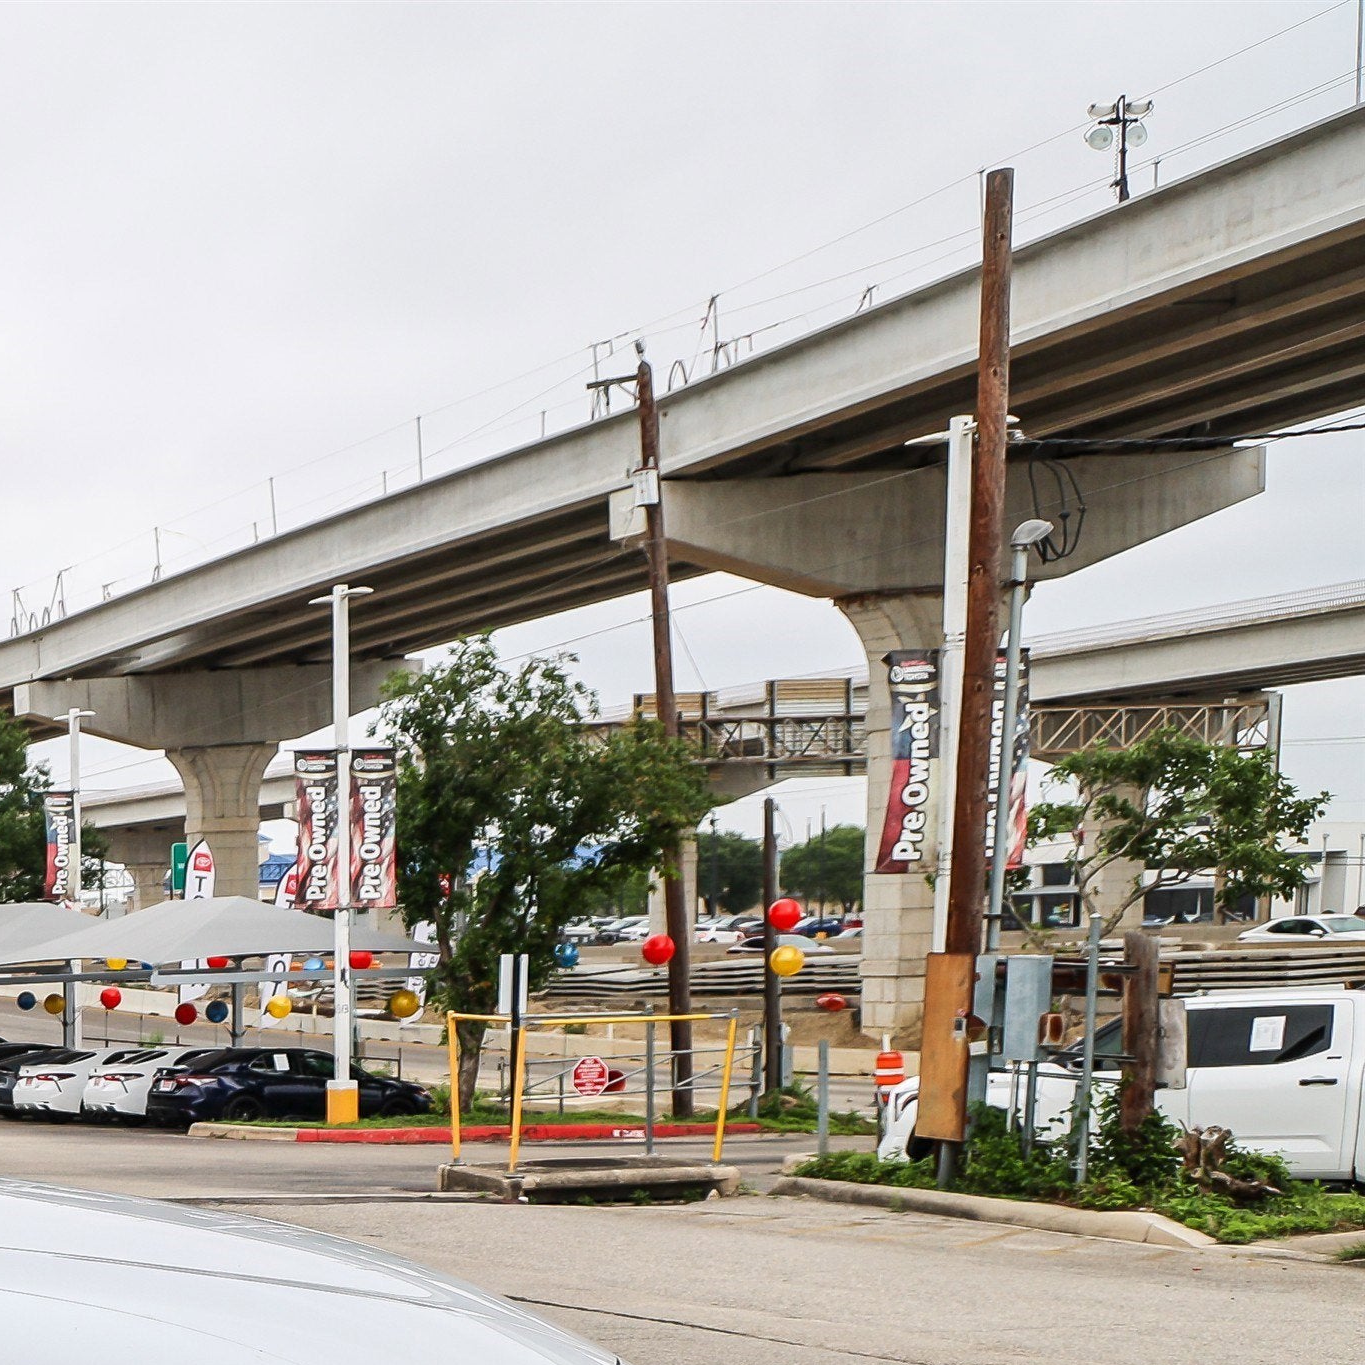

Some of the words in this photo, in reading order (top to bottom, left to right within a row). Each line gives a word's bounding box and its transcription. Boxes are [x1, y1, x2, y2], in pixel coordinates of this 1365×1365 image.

[902, 702, 929, 807] Owned
[53, 815, 68, 867] Owned
[306, 786, 327, 861] Owned
[360, 786, 381, 860] Owned
[891, 811, 926, 860] Pre
[52, 869, 68, 894] Pre
[306, 863, 328, 900] Pre
[360, 863, 382, 900] Pre
